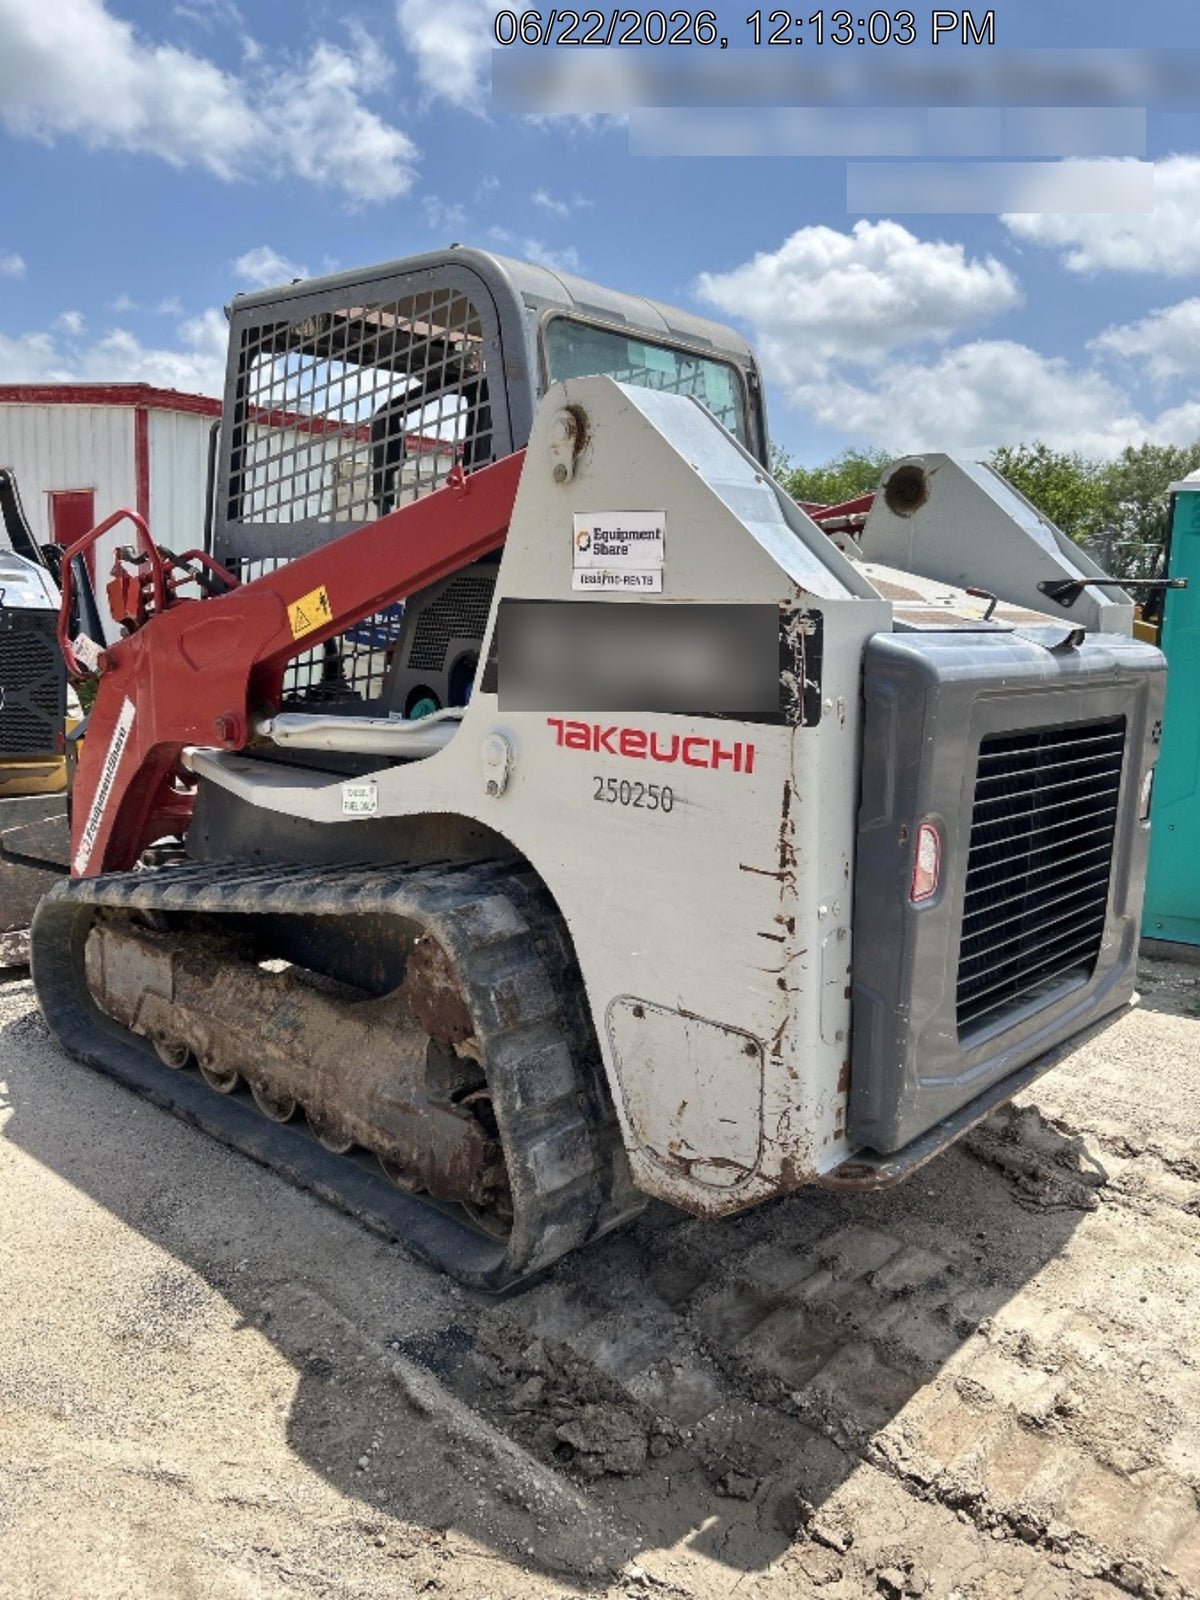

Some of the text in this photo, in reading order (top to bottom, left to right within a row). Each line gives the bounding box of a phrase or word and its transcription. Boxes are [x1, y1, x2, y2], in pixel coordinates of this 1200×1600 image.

[593, 527, 661, 542] Equipment
[593, 543, 628, 555] Share
[593, 776, 674, 813] 250250
